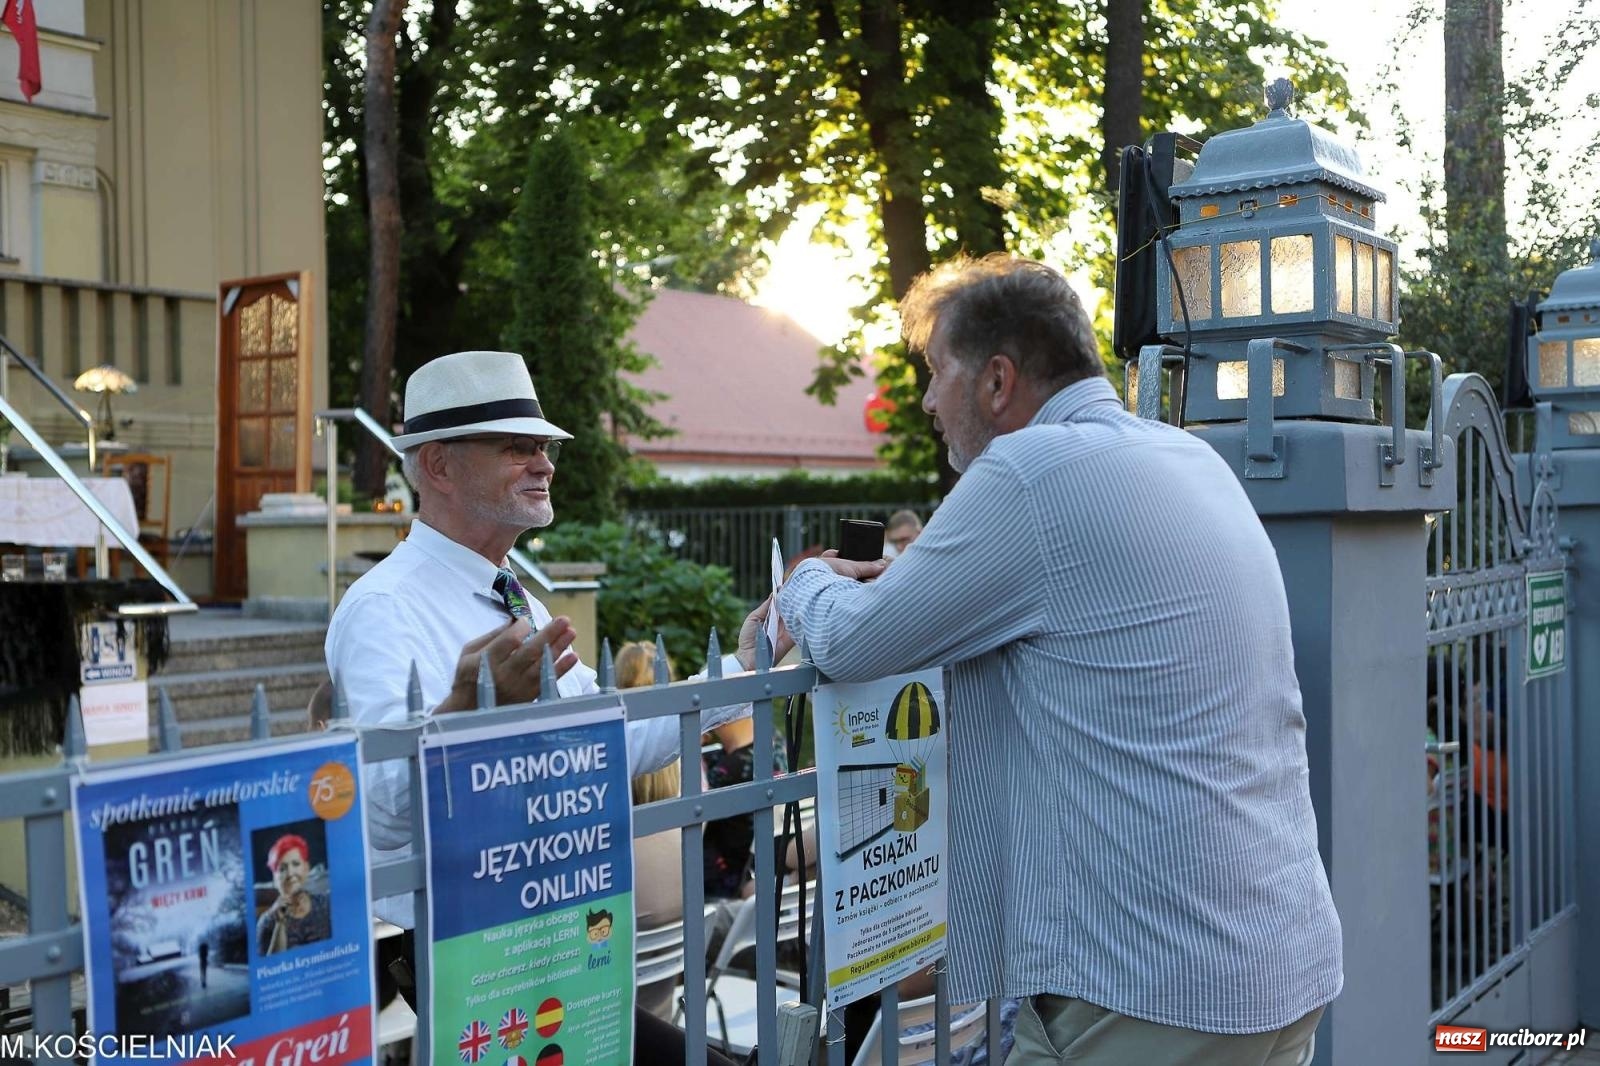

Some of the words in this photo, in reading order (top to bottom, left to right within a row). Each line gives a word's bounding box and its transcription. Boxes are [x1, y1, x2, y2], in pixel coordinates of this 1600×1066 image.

[101, 667, 132, 678] WINDA
[848, 707, 879, 727] InPost
[471, 743, 608, 793] DARMOWE
[89, 786, 200, 831] spotkanie
[204, 770, 300, 809] autorskie
[526, 783, 608, 825] KURSY
[128, 819, 219, 889] GREŃ
[472, 823, 611, 882] JĘZYKOWE
[862, 833, 918, 871] KSIĄŻKI
[520, 862, 612, 909] ONLINE
[835, 890, 845, 912] Z
[850, 854, 940, 907] PACZKOMATU
[482, 927, 513, 943] Nauka
[514, 920, 545, 938] języka
[545, 910, 580, 925] obcego
[837, 911, 858, 925] Zamów
[883, 896, 903, 908] odbierz
[512, 936, 551, 955] aplikacją
[553, 926, 580, 943] LERNI
[860, 926, 873, 937] Tylko
[256, 961, 295, 980] Pisarka
[471, 971, 497, 986] Gdzie
[528, 954, 551, 971] kiedy
[850, 957, 880, 975] Regulamin
[465, 992, 487, 1007] Tylko
[488, 988, 501, 1000] dla
[264, 1013, 350, 1066] Greń
